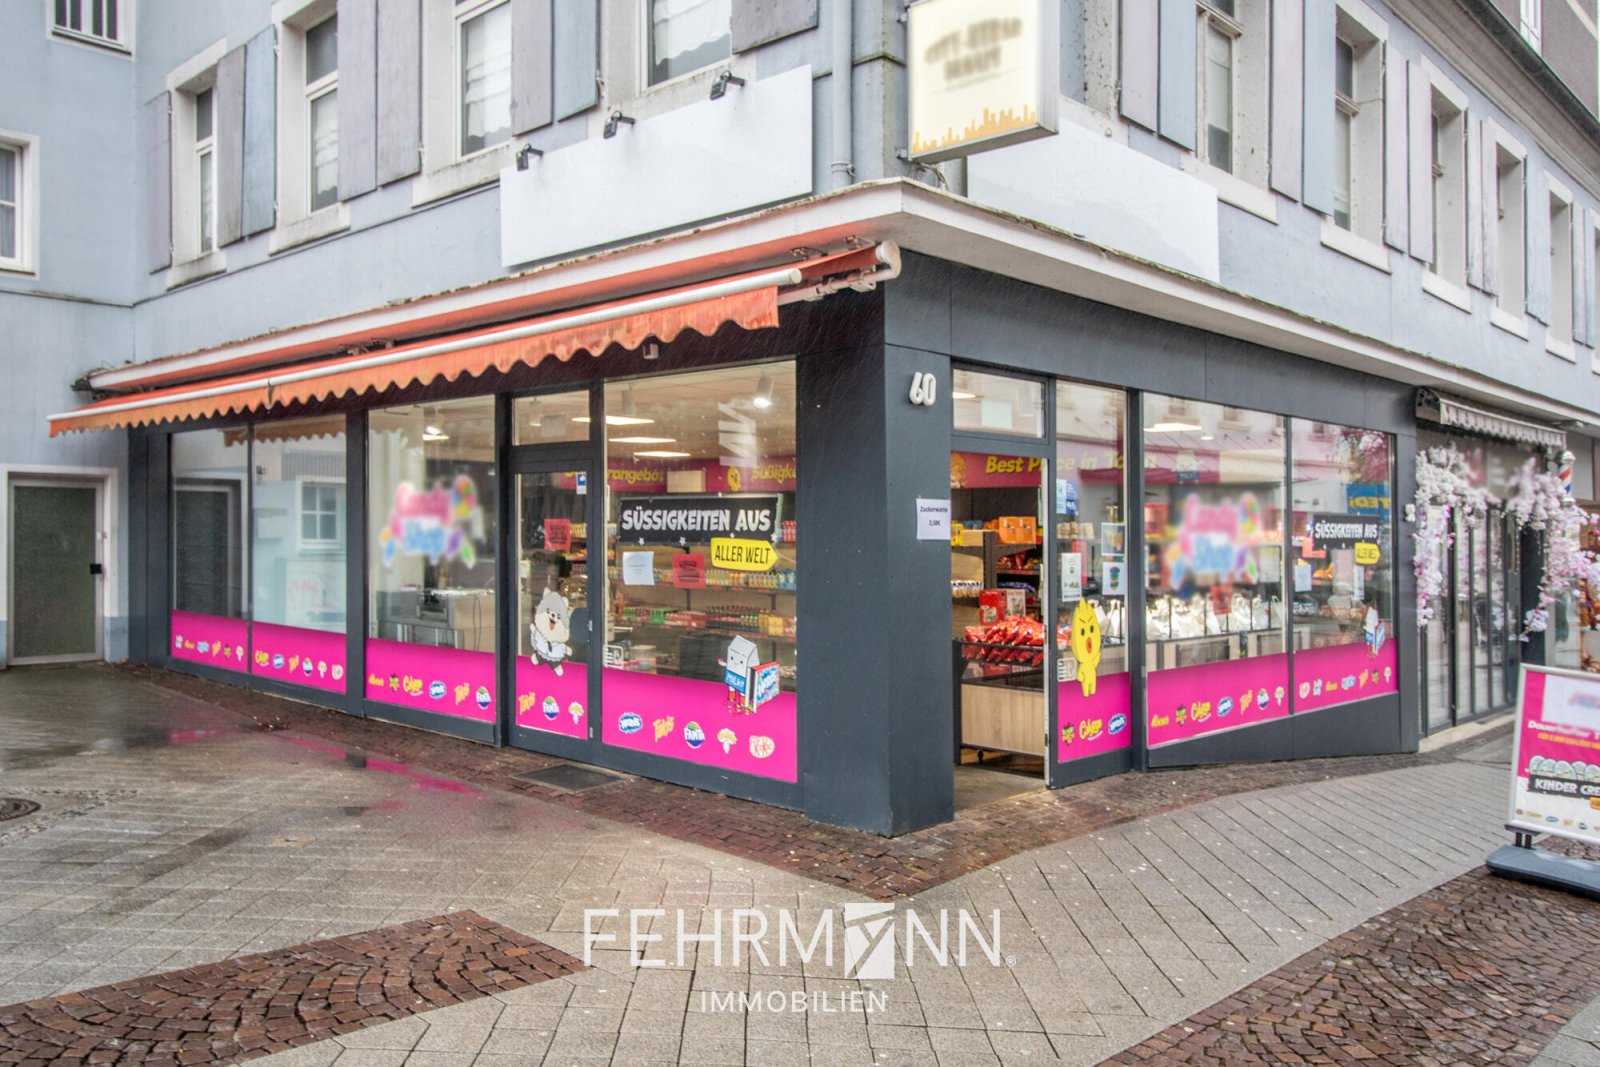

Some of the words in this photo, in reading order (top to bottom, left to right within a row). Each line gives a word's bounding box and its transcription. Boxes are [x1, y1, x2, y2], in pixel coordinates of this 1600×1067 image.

[909, 371, 937, 406] 60
[985, 455, 1024, 473] Best
[622, 506, 731, 531] SÜSSIGKEITEN
[735, 509, 771, 532] AUS
[714, 544, 743, 563] ALLER
[746, 547, 771, 565] WELT
[1534, 778, 1578, 794] KINDER
